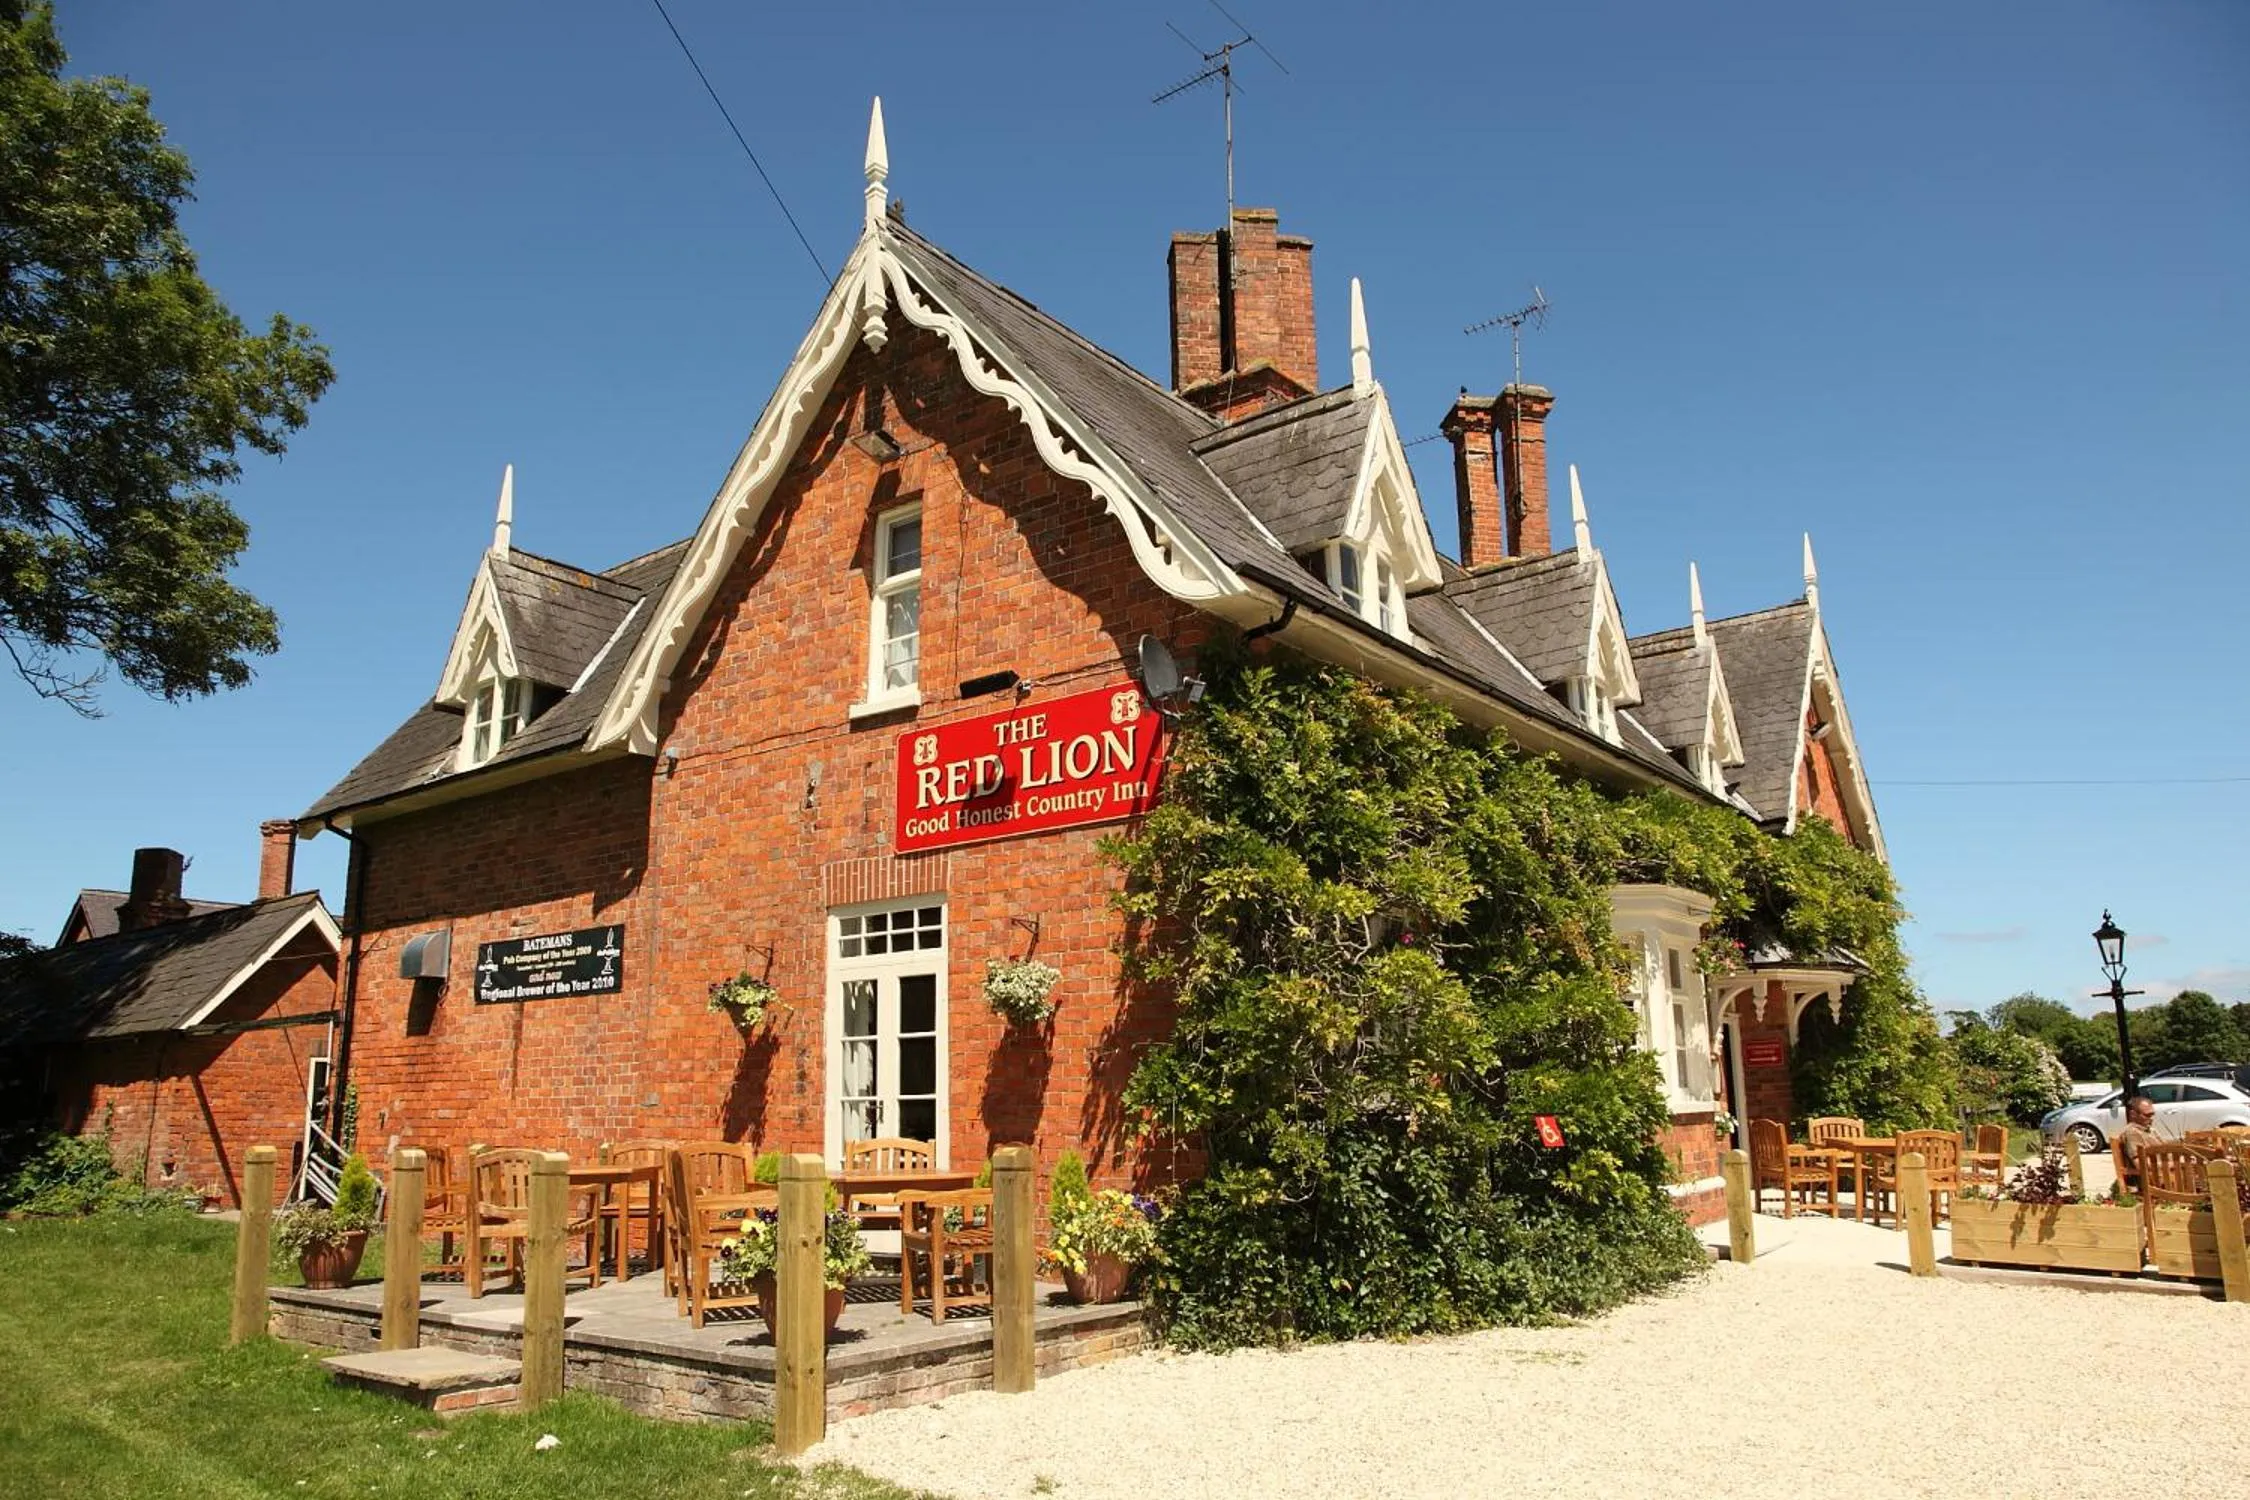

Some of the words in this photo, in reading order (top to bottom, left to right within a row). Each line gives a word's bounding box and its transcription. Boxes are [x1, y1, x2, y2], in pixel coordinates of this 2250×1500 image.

[993, 713, 1048, 746] THE
[916, 754, 1005, 809] RED
[1020, 725, 1136, 789] LION
[905, 810, 949, 838] Good
[956, 801, 1021, 829] Honest
[1027, 786, 1107, 816] Country
[1113, 780, 1149, 802] Inn
[523, 934, 573, 951] BATEMANS
[480, 986, 515, 1000] Regional
[517, 984, 544, 998] Brewer
[545, 982, 555, 994] of
[556, 981, 571, 993] the
[572, 979, 591, 992] Year
[591, 976, 615, 990] 2010
